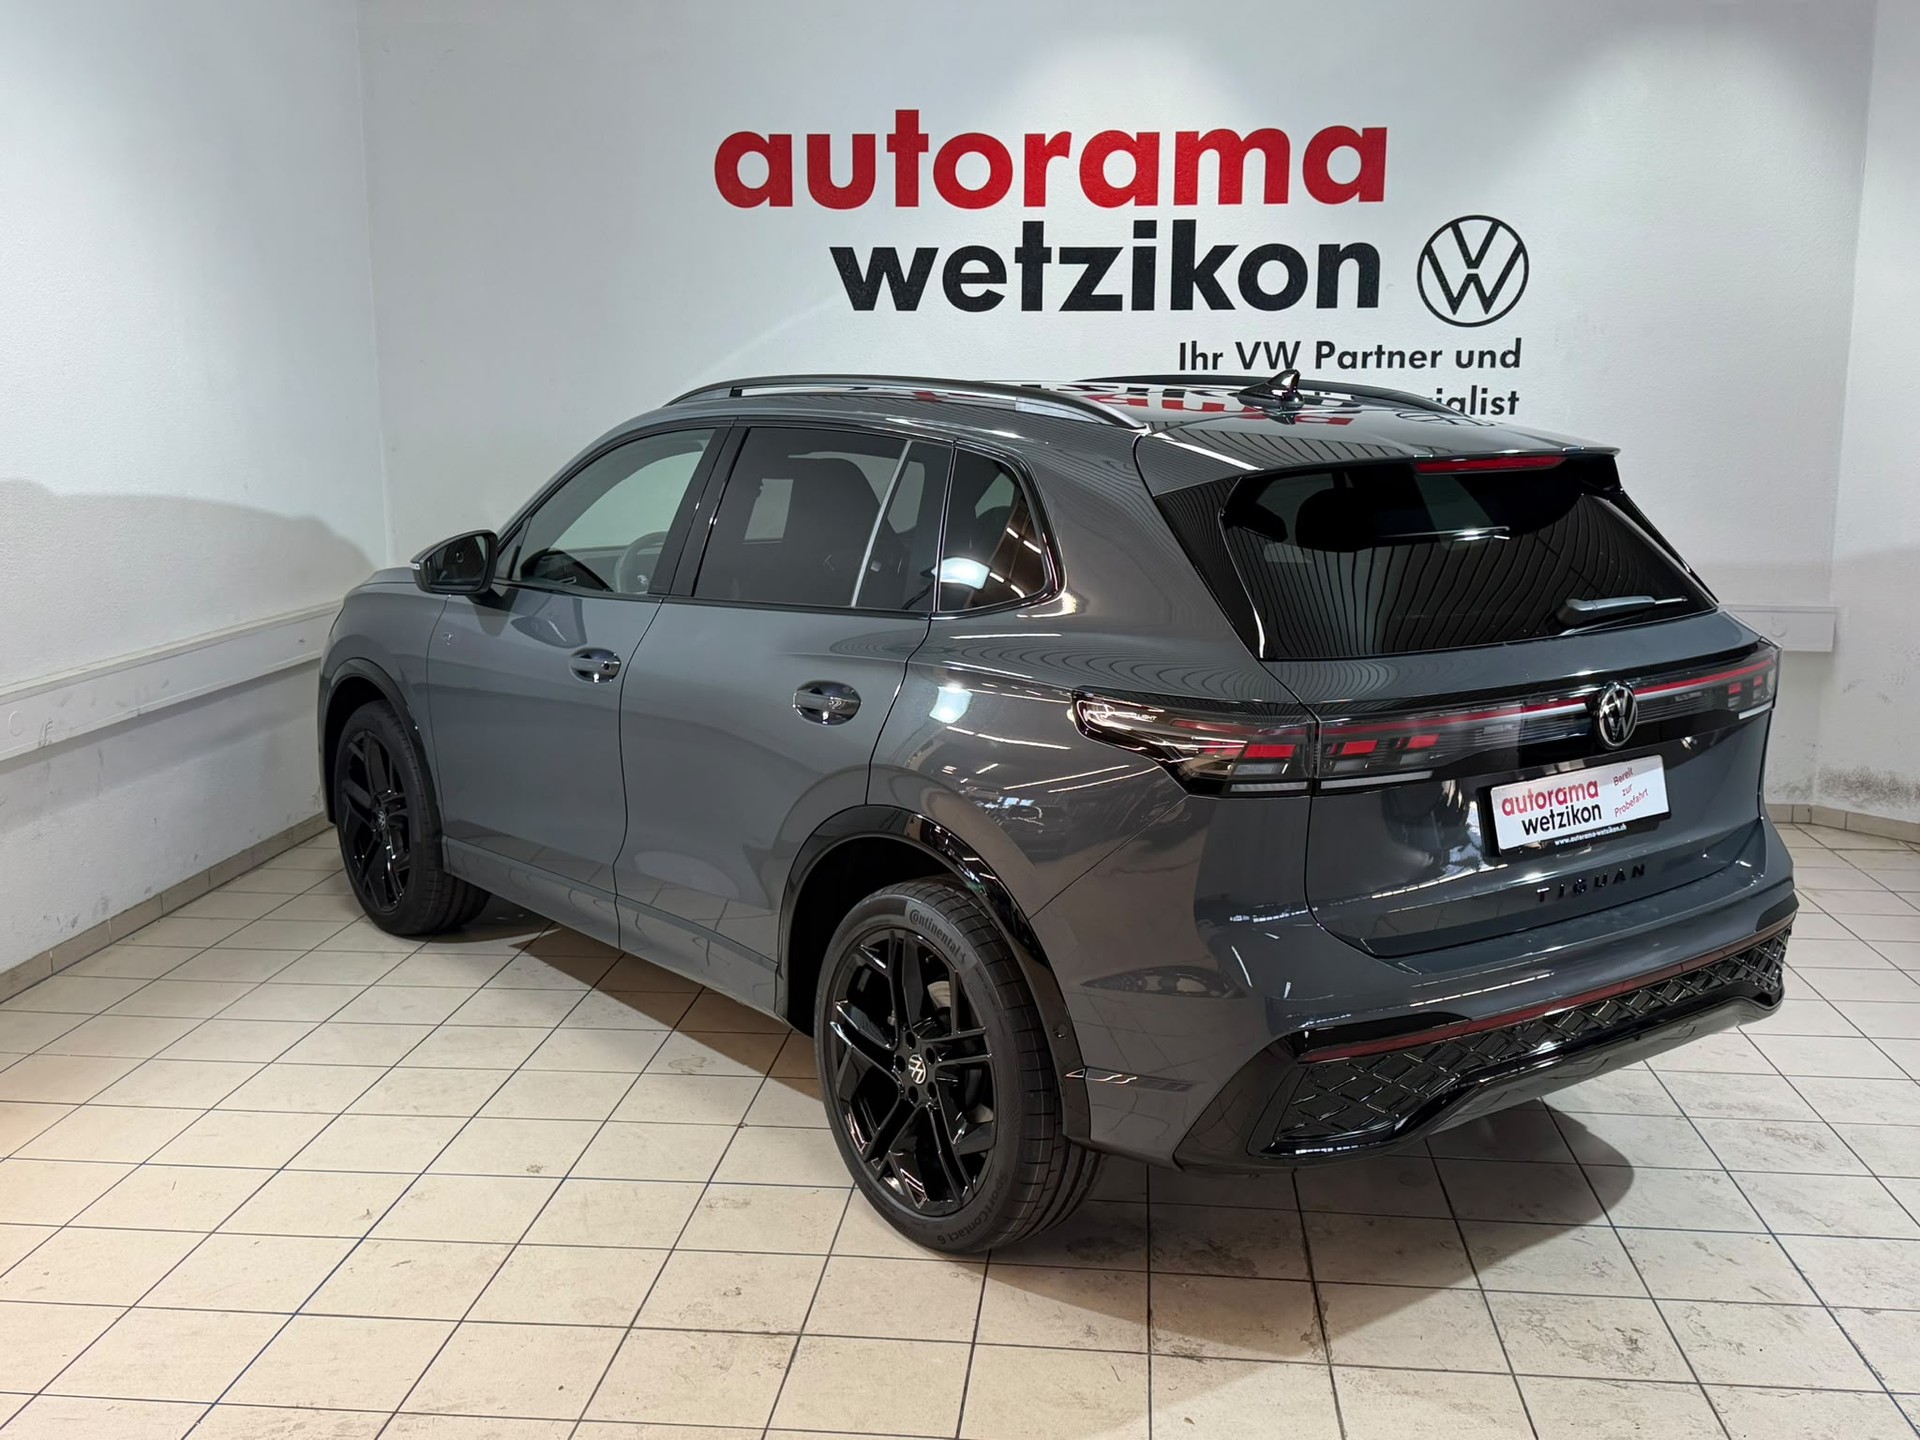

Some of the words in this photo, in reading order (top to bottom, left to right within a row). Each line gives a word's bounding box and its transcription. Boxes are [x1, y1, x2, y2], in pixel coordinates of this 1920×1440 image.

[715, 110, 1387, 211] autorama
[830, 219, 1381, 313] wetzikon
[1179, 340, 1224, 371] Ihr
[1235, 340, 1301, 370] VW
[1315, 340, 1443, 370] Partner
[1455, 337, 1522, 369] und
[1613, 767, 1634, 787] Bereit
[1622, 784, 1633, 797] zur
[1501, 780, 1600, 816] autorama
[1614, 788, 1649, 818] Probefahrt
[1521, 803, 1602, 836] wetzikon
[1536, 863, 1646, 902] TIGUAN
[909, 909, 961, 957] Continental
